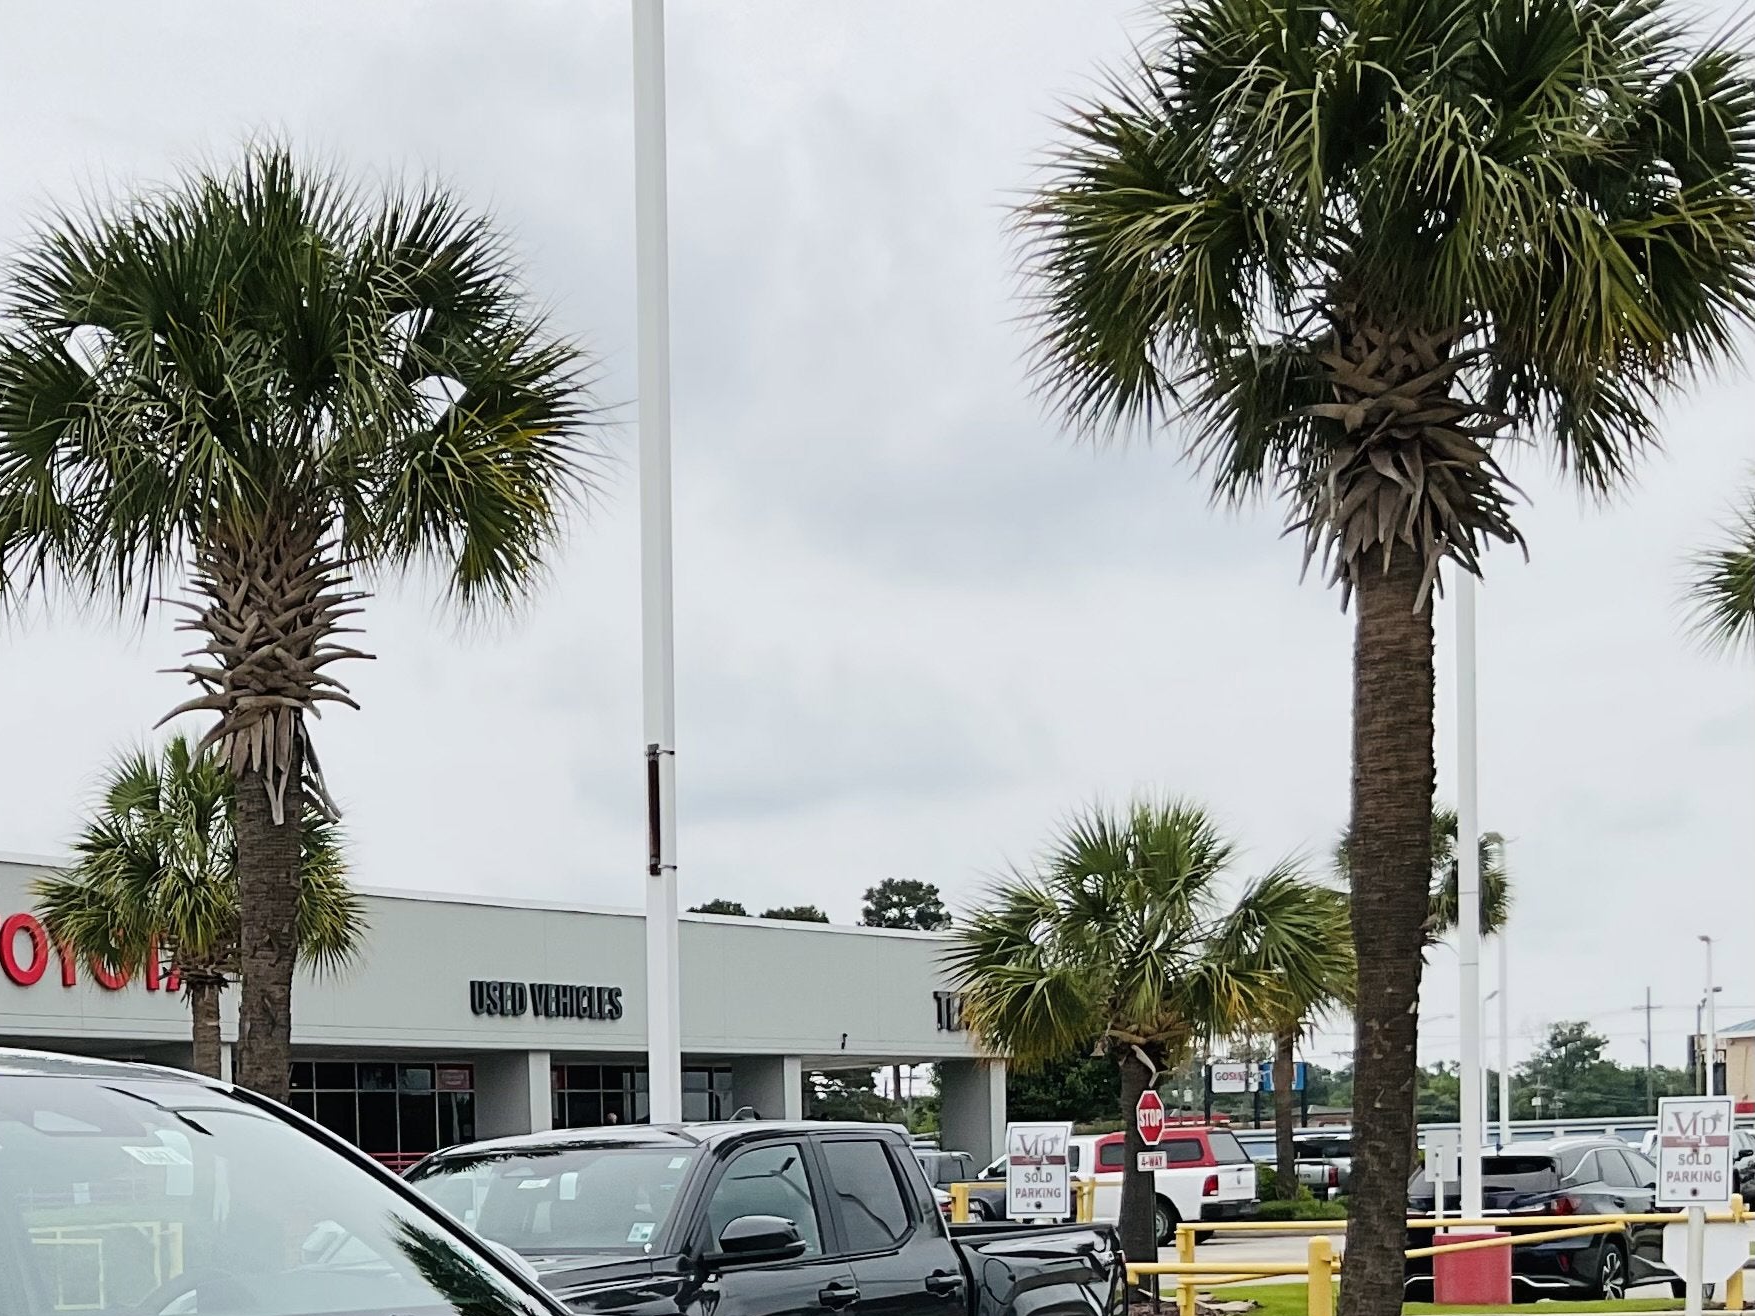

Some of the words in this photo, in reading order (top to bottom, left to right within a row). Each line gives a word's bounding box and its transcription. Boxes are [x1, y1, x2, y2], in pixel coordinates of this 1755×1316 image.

[469, 980, 528, 1016] USED
[529, 982, 624, 1021] VEHICLES
[1139, 1108, 1162, 1127] STOP
[1141, 1155, 1163, 1167] 4-WAY
[1678, 1153, 1712, 1166] SOLD
[1024, 1172, 1053, 1183] SOLD
[1666, 1170, 1722, 1183] PARKING
[1015, 1187, 1062, 1199] PARKING
